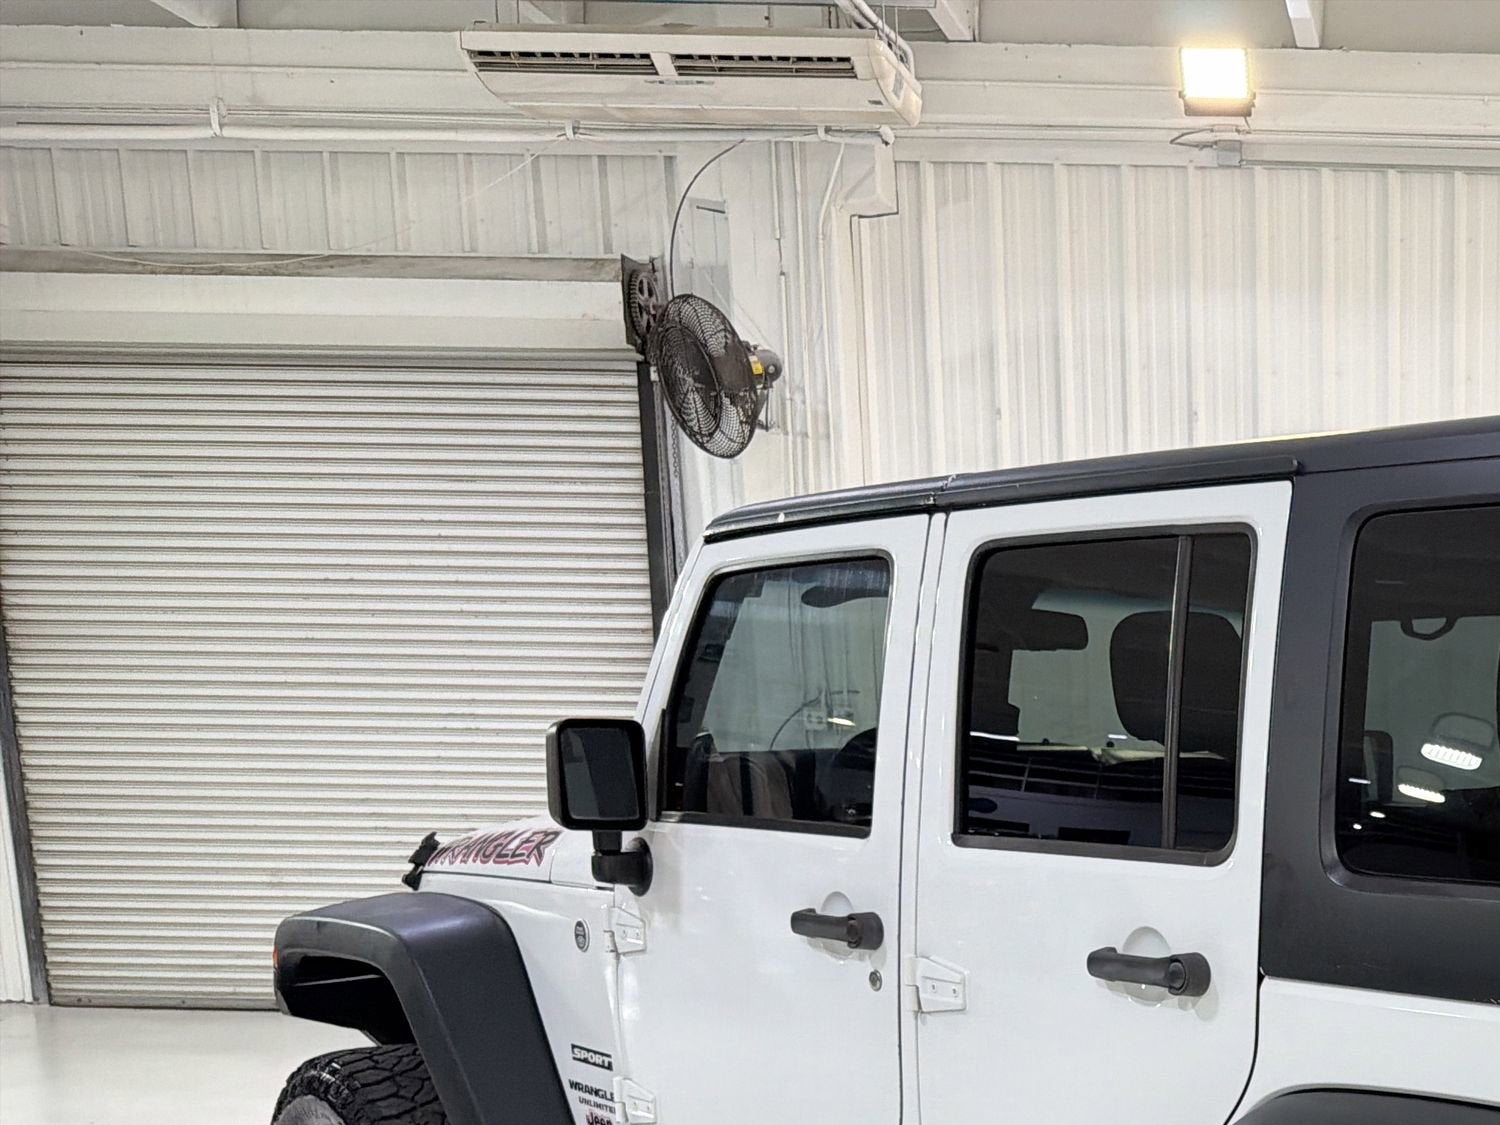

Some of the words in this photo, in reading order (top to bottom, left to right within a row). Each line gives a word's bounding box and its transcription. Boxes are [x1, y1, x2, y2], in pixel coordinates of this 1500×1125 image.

[427, 828, 562, 867] WRANGLER
[573, 1047, 611, 1069] SPORT
[568, 1079, 615, 1102] WRANGLE
[578, 1095, 616, 1114] UNLIMITE
